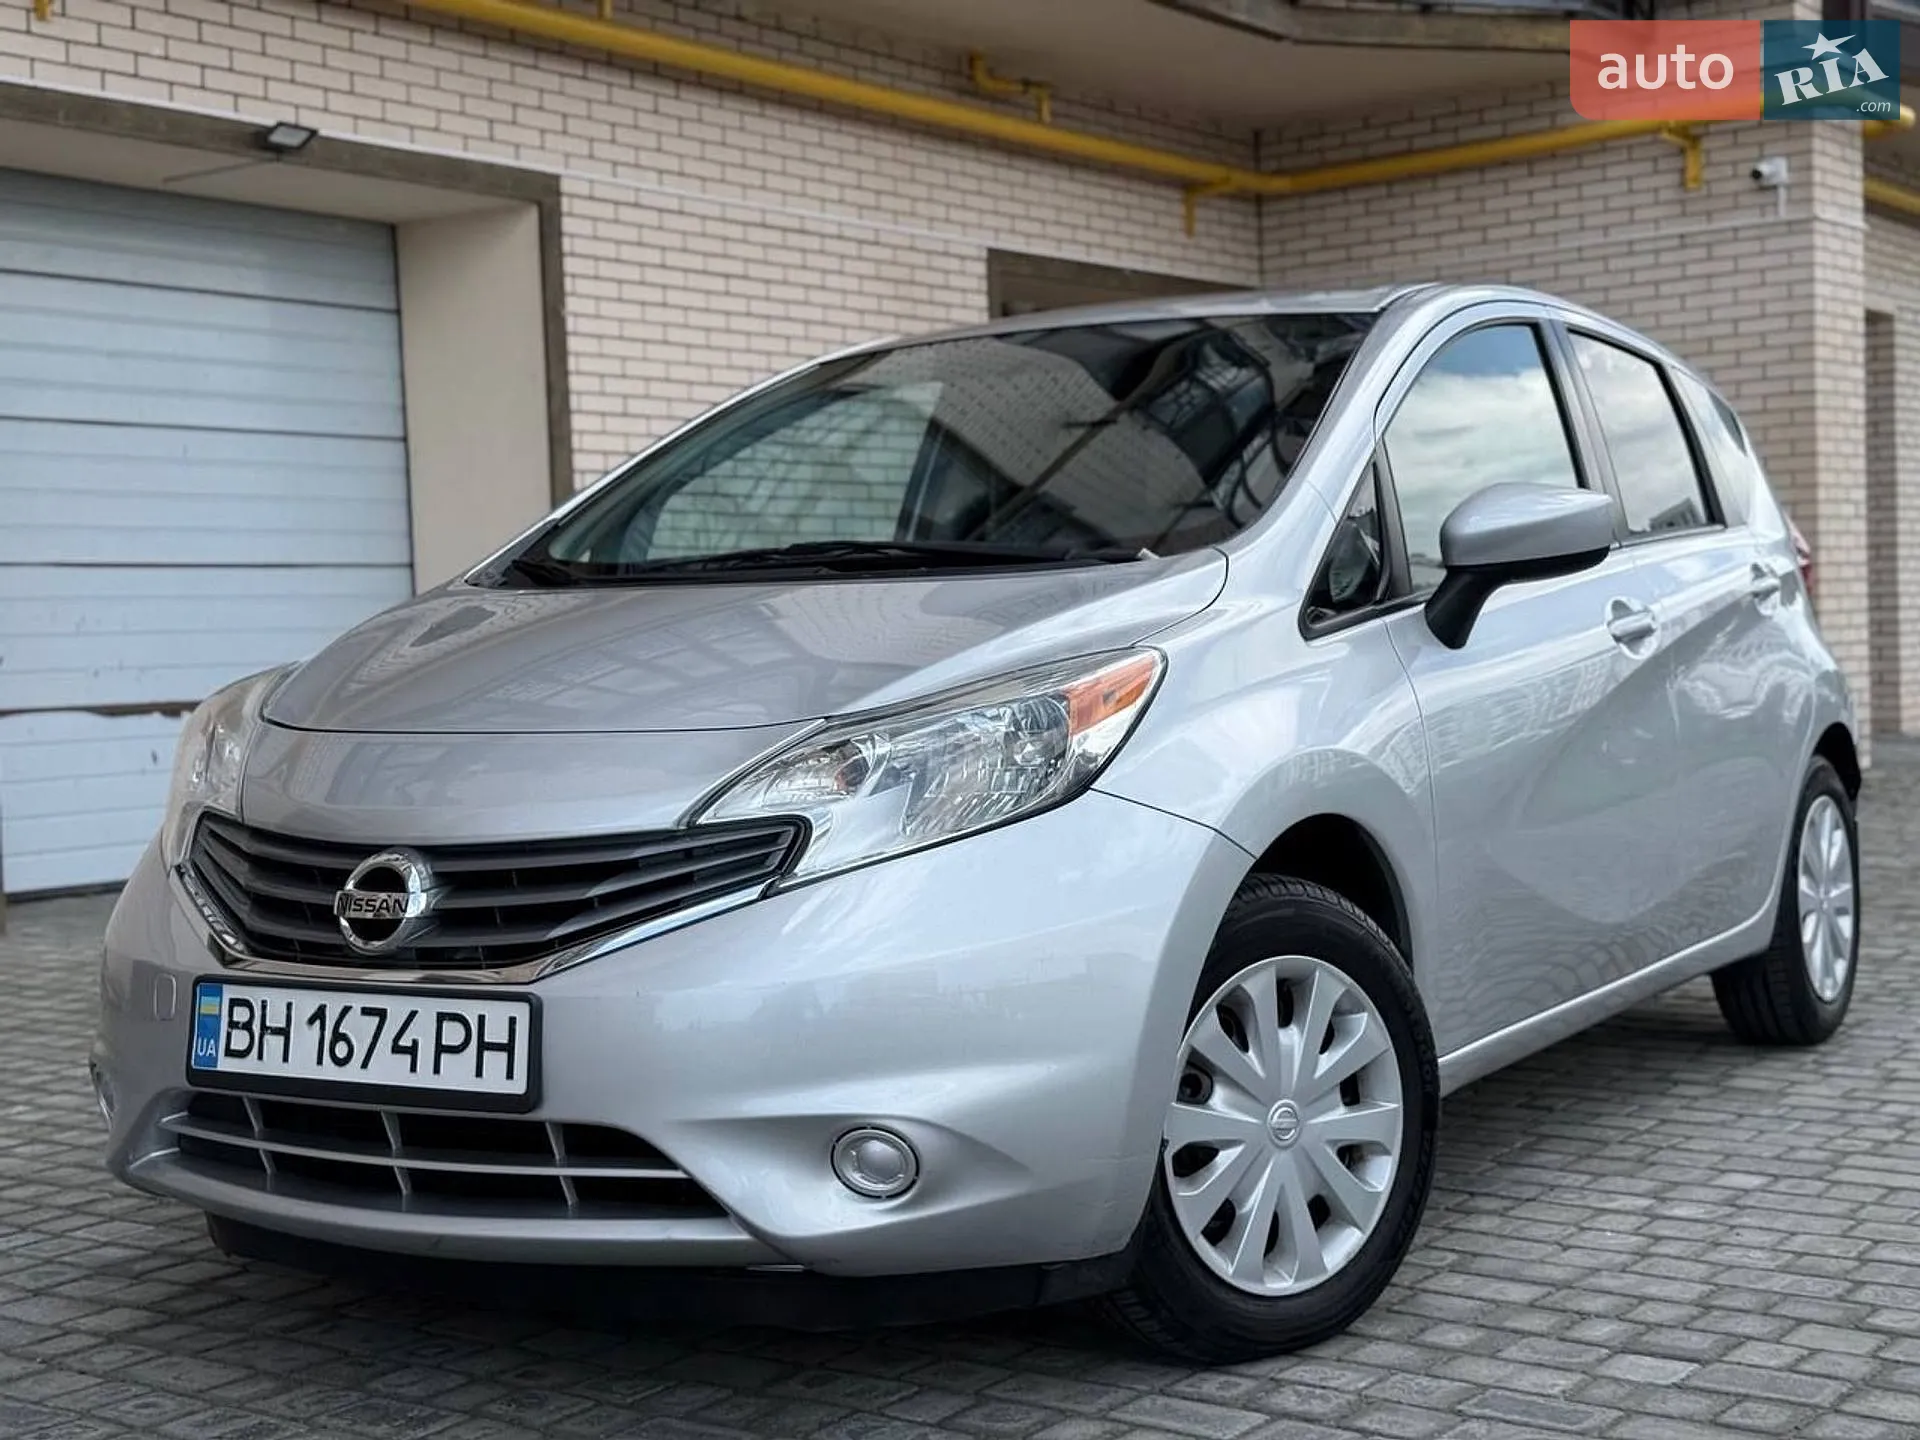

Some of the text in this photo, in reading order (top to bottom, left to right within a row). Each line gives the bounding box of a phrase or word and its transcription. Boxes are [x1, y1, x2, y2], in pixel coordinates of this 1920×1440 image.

[337, 894, 409, 917] NISSAN
[198, 1036, 217, 1058] UA
[224, 997, 518, 1081] BH 1674 PH
